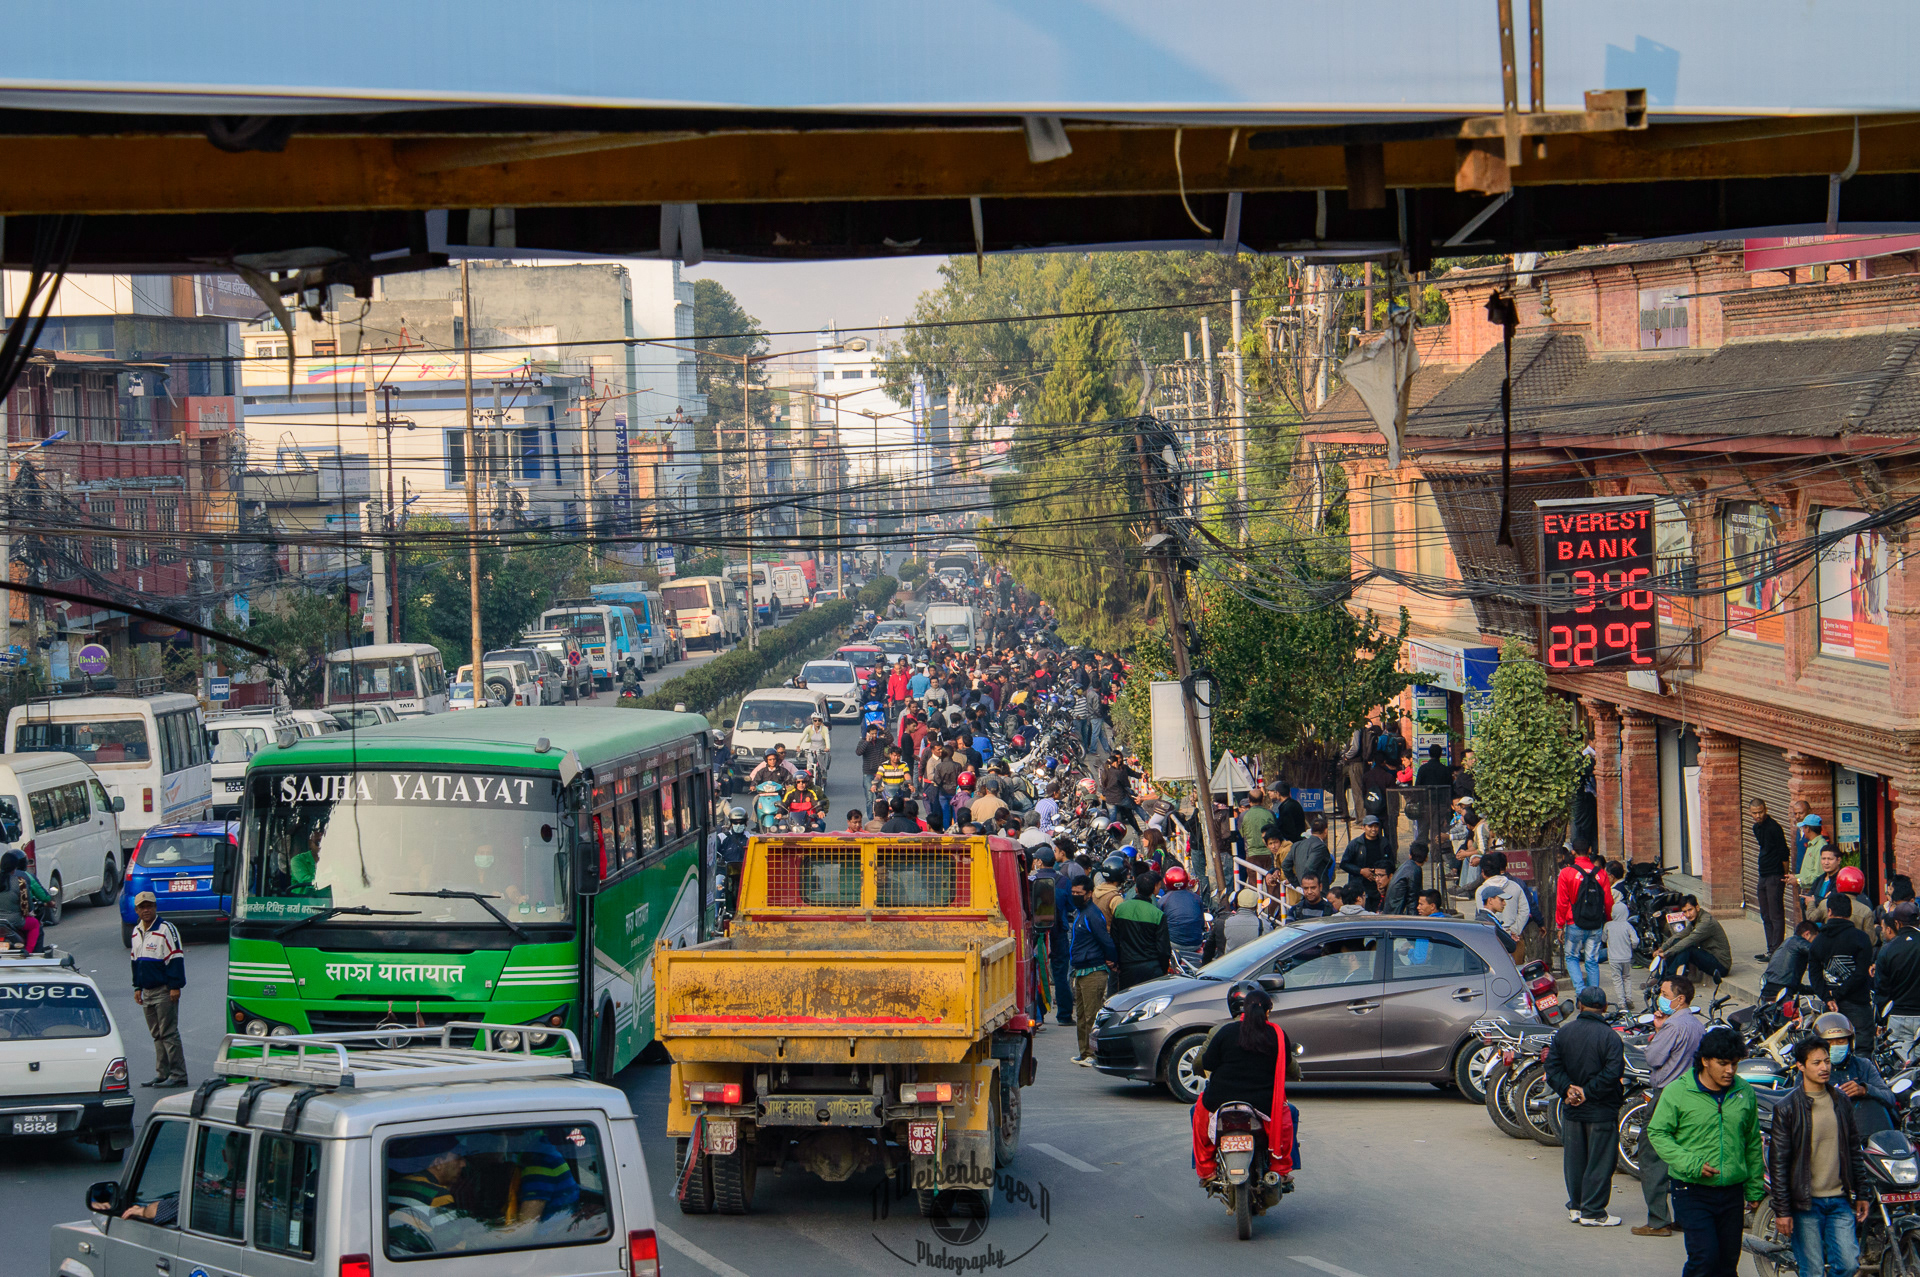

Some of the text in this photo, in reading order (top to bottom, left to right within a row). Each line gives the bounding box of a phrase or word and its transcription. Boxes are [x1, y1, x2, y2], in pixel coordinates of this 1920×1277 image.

[205, 512, 233, 522] ATM
[1544, 510, 1650, 534] EVEREST
[1558, 537, 1638, 560] BANK
[281, 774, 534, 805] SAJHA YATAYAT
[1507, 861, 1528, 869] ITED
[325, 963, 466, 983] साझा यातायात
[0, 985, 89, 1000] NGEL
